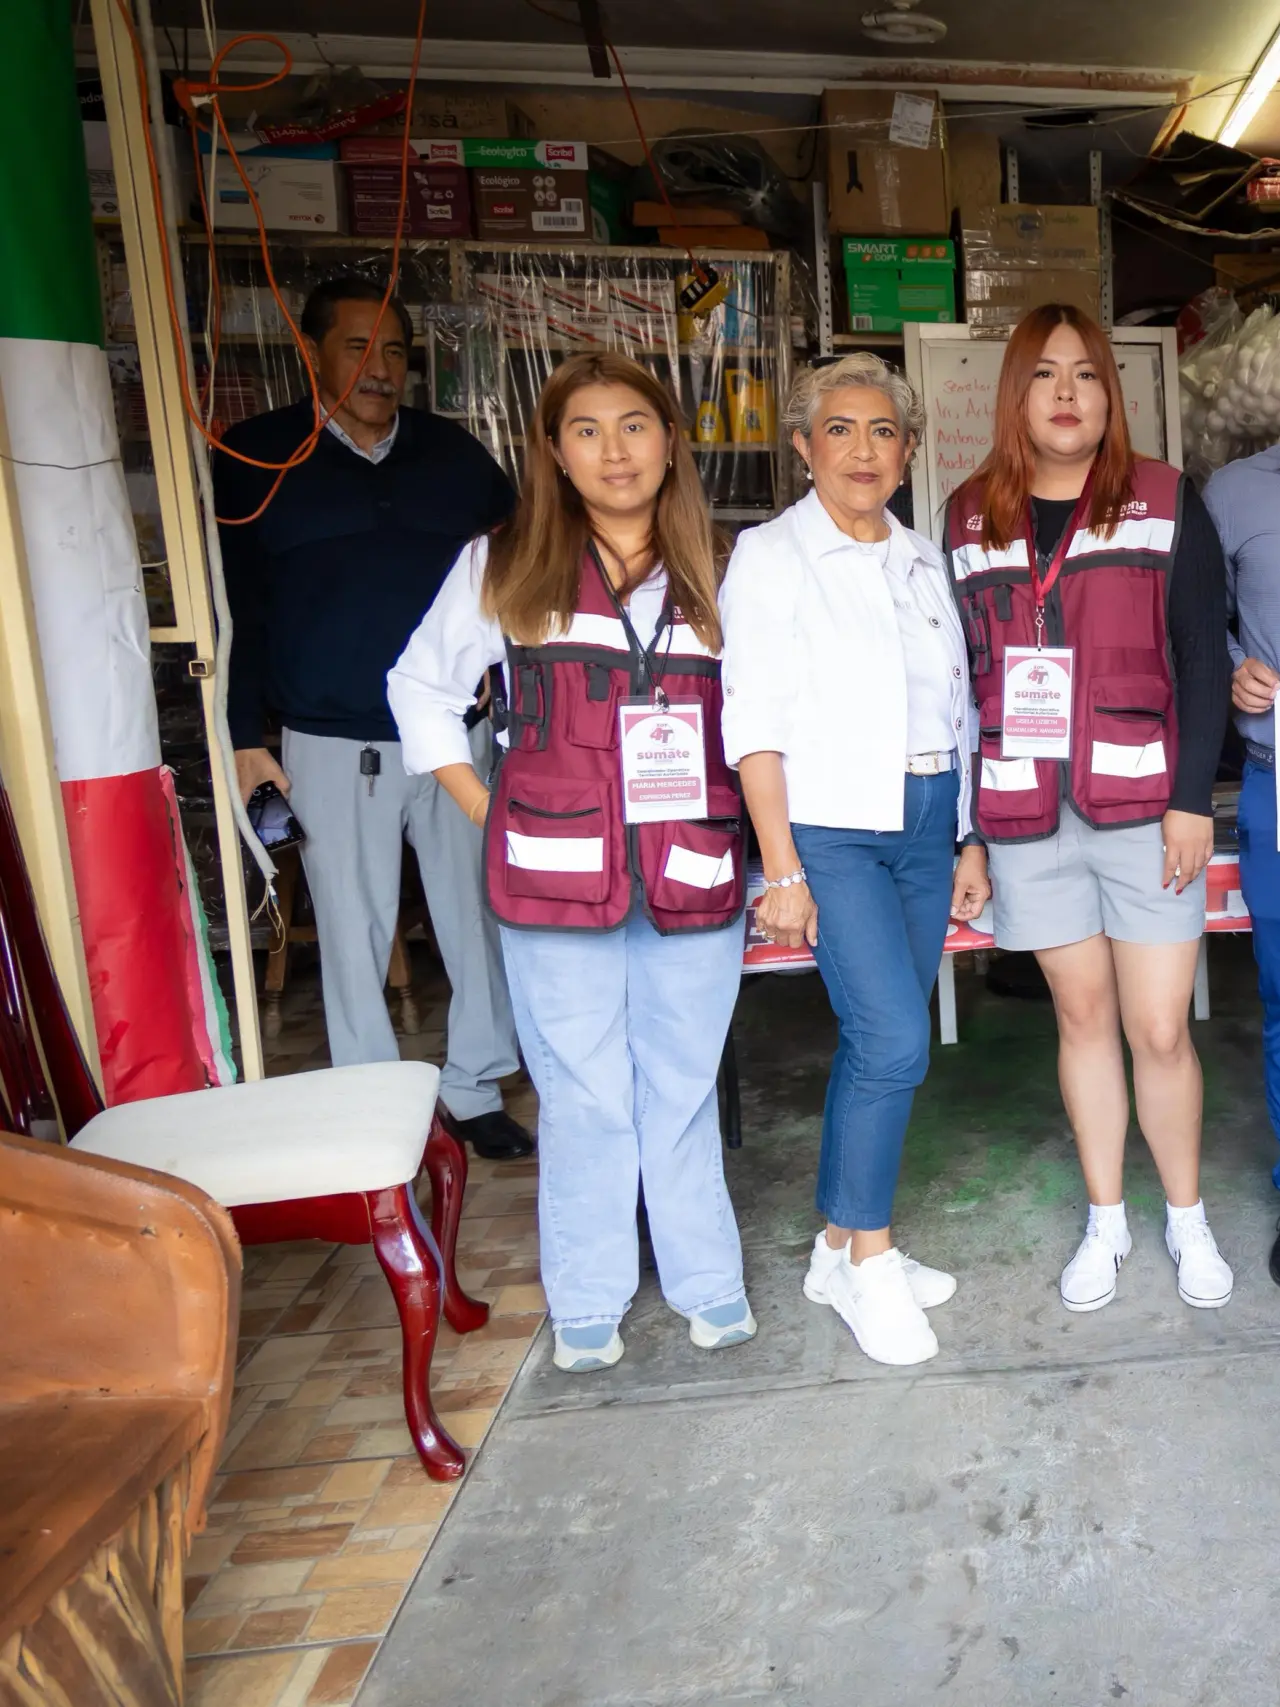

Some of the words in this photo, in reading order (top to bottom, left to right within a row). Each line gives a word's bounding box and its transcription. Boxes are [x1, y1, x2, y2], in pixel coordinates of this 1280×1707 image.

[479, 145, 528, 160] Ecológico
[479, 175, 521, 188] Ecológico
[847, 242, 898, 254] SMART
